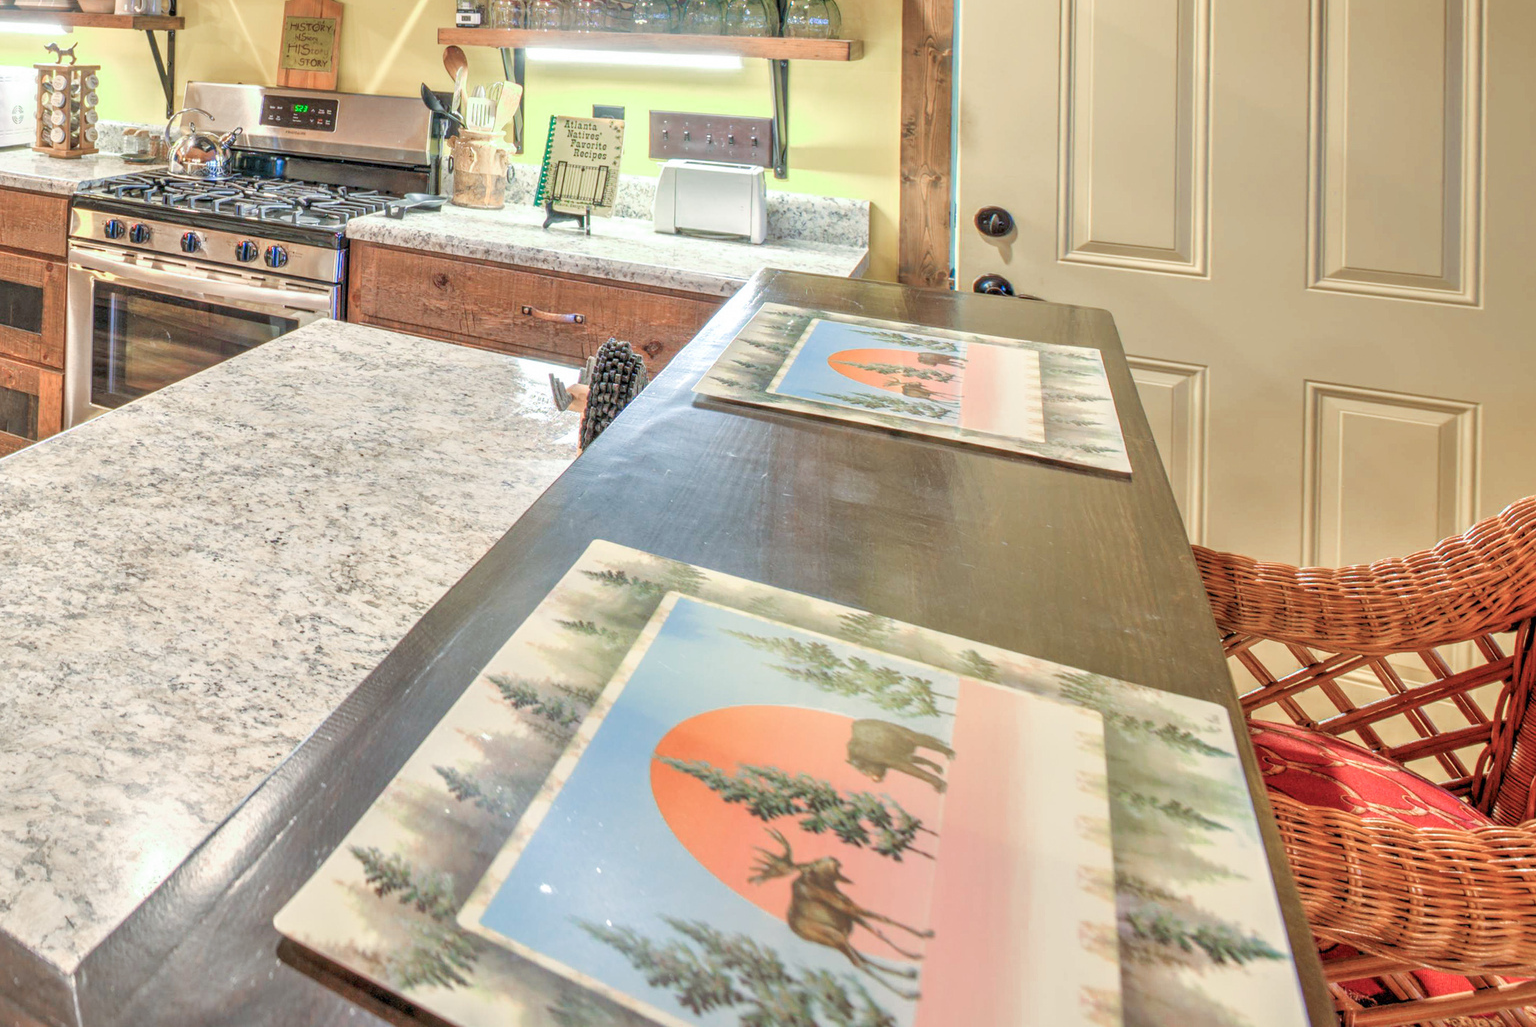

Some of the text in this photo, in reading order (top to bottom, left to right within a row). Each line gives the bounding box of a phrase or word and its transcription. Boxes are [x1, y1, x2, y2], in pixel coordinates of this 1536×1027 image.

[290, 22, 332, 33] HISTORY
[298, 57, 329, 68] STORY
[564, 119, 598, 131] Atlanta
[567, 129, 603, 141] Natives'
[570, 139, 607, 151] Favorite
[573, 148, 607, 162] Recipes
